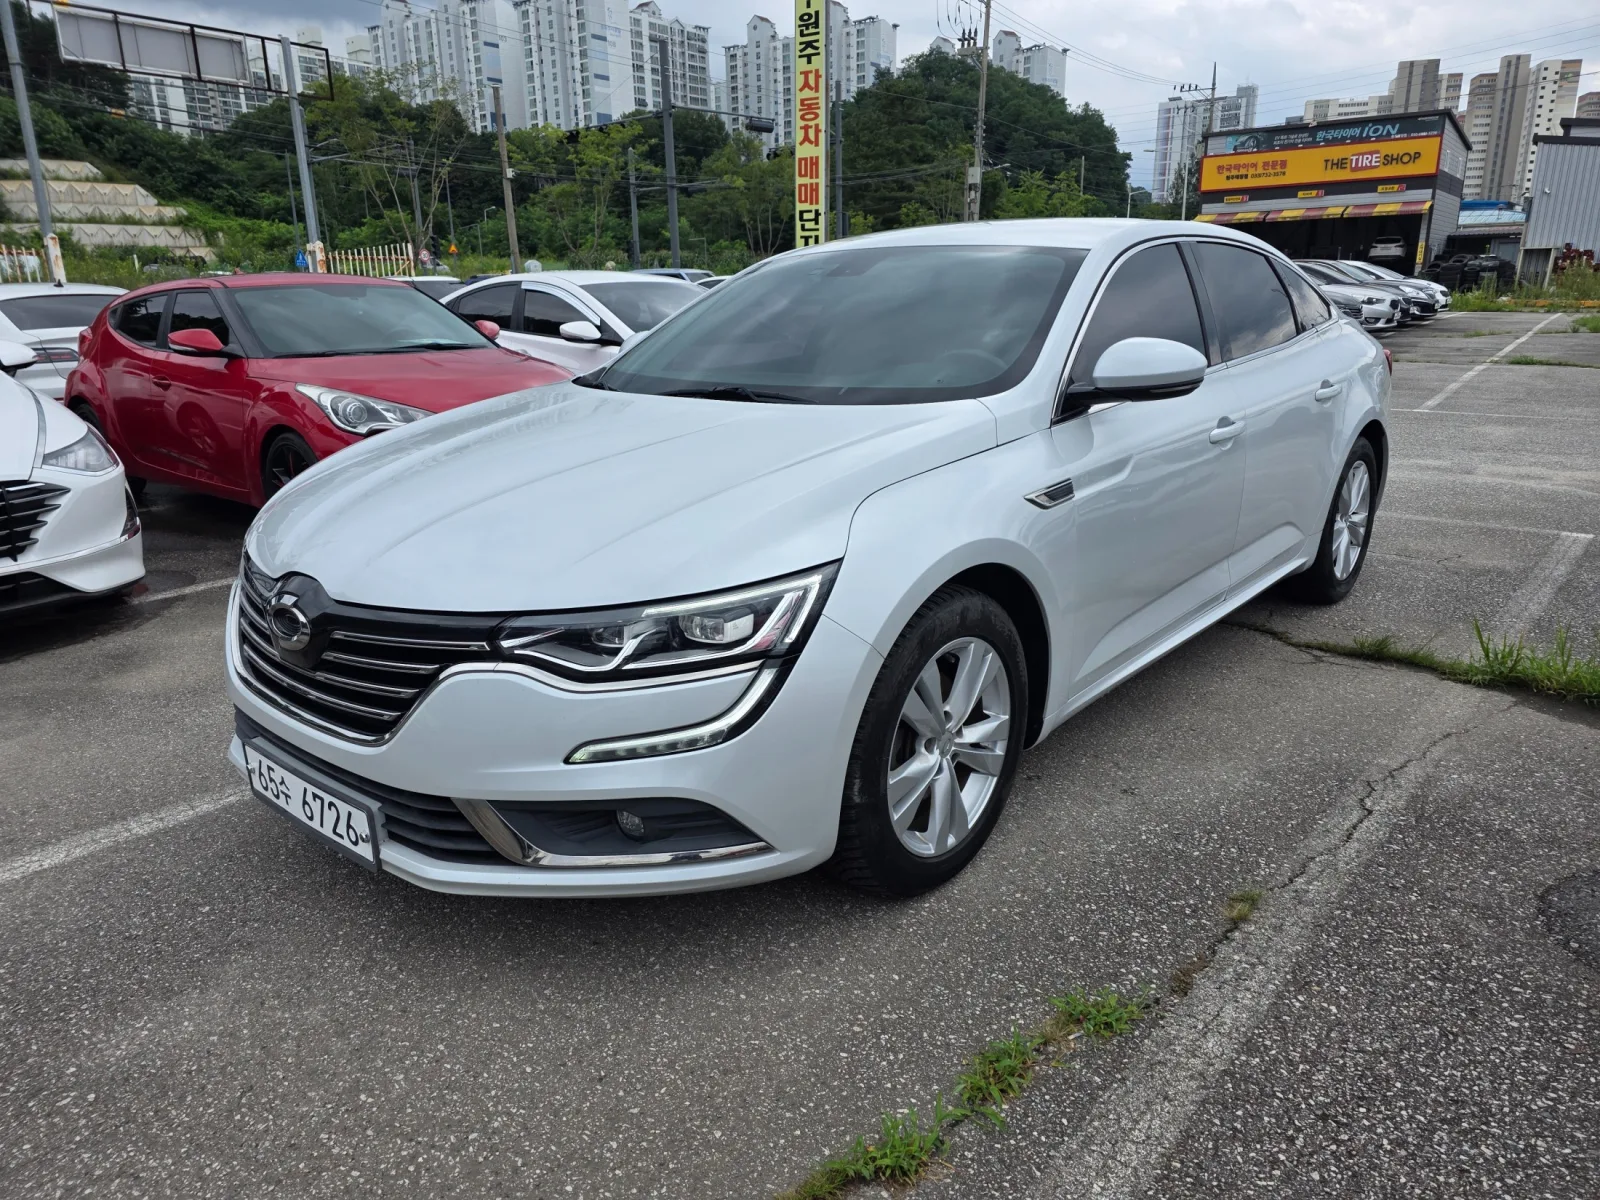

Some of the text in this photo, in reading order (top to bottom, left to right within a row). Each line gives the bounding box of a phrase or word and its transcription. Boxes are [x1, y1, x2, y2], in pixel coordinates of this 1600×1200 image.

[798, 10, 821, 65] 원주
[798, 68, 822, 148] 자동차
[1316, 127, 1361, 140] 한국타이어
[1216, 159, 1288, 175] 한국타이어 전문점
[1323, 151, 1422, 171] THE TIRE SHOP
[258, 759, 359, 846] 65수 6726
